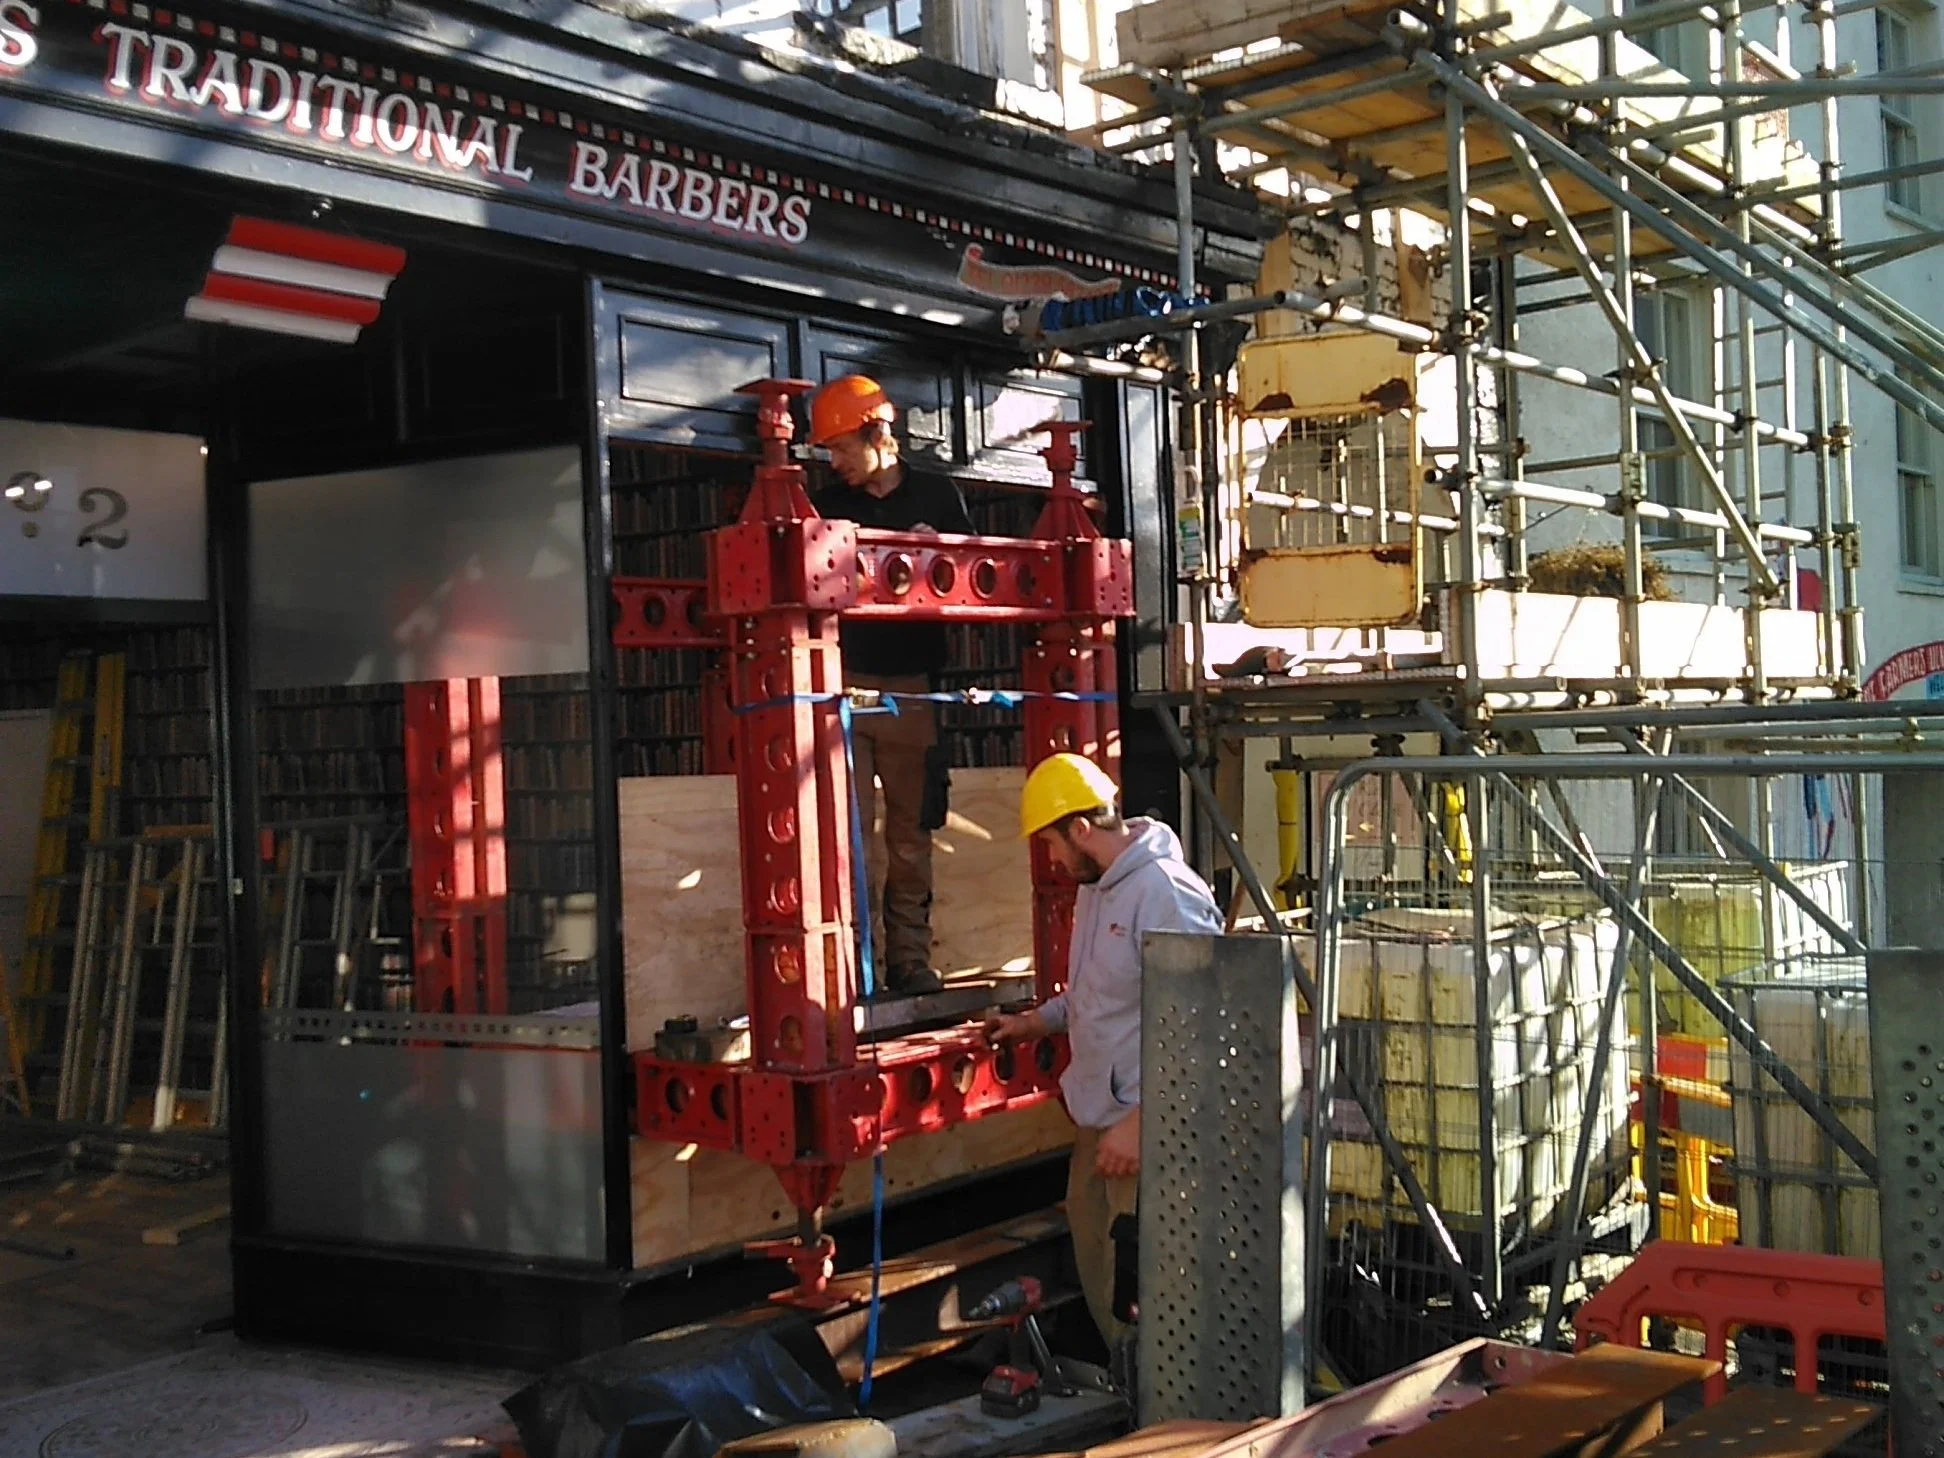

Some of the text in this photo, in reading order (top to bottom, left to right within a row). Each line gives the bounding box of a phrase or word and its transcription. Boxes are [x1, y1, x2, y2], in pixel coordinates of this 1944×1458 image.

[98, 22, 533, 185] TRADITIONAL
[568, 140, 811, 245] BARBERS
[76, 487, 128, 549] 2
[1878, 648, 1926, 699] FARMERS
